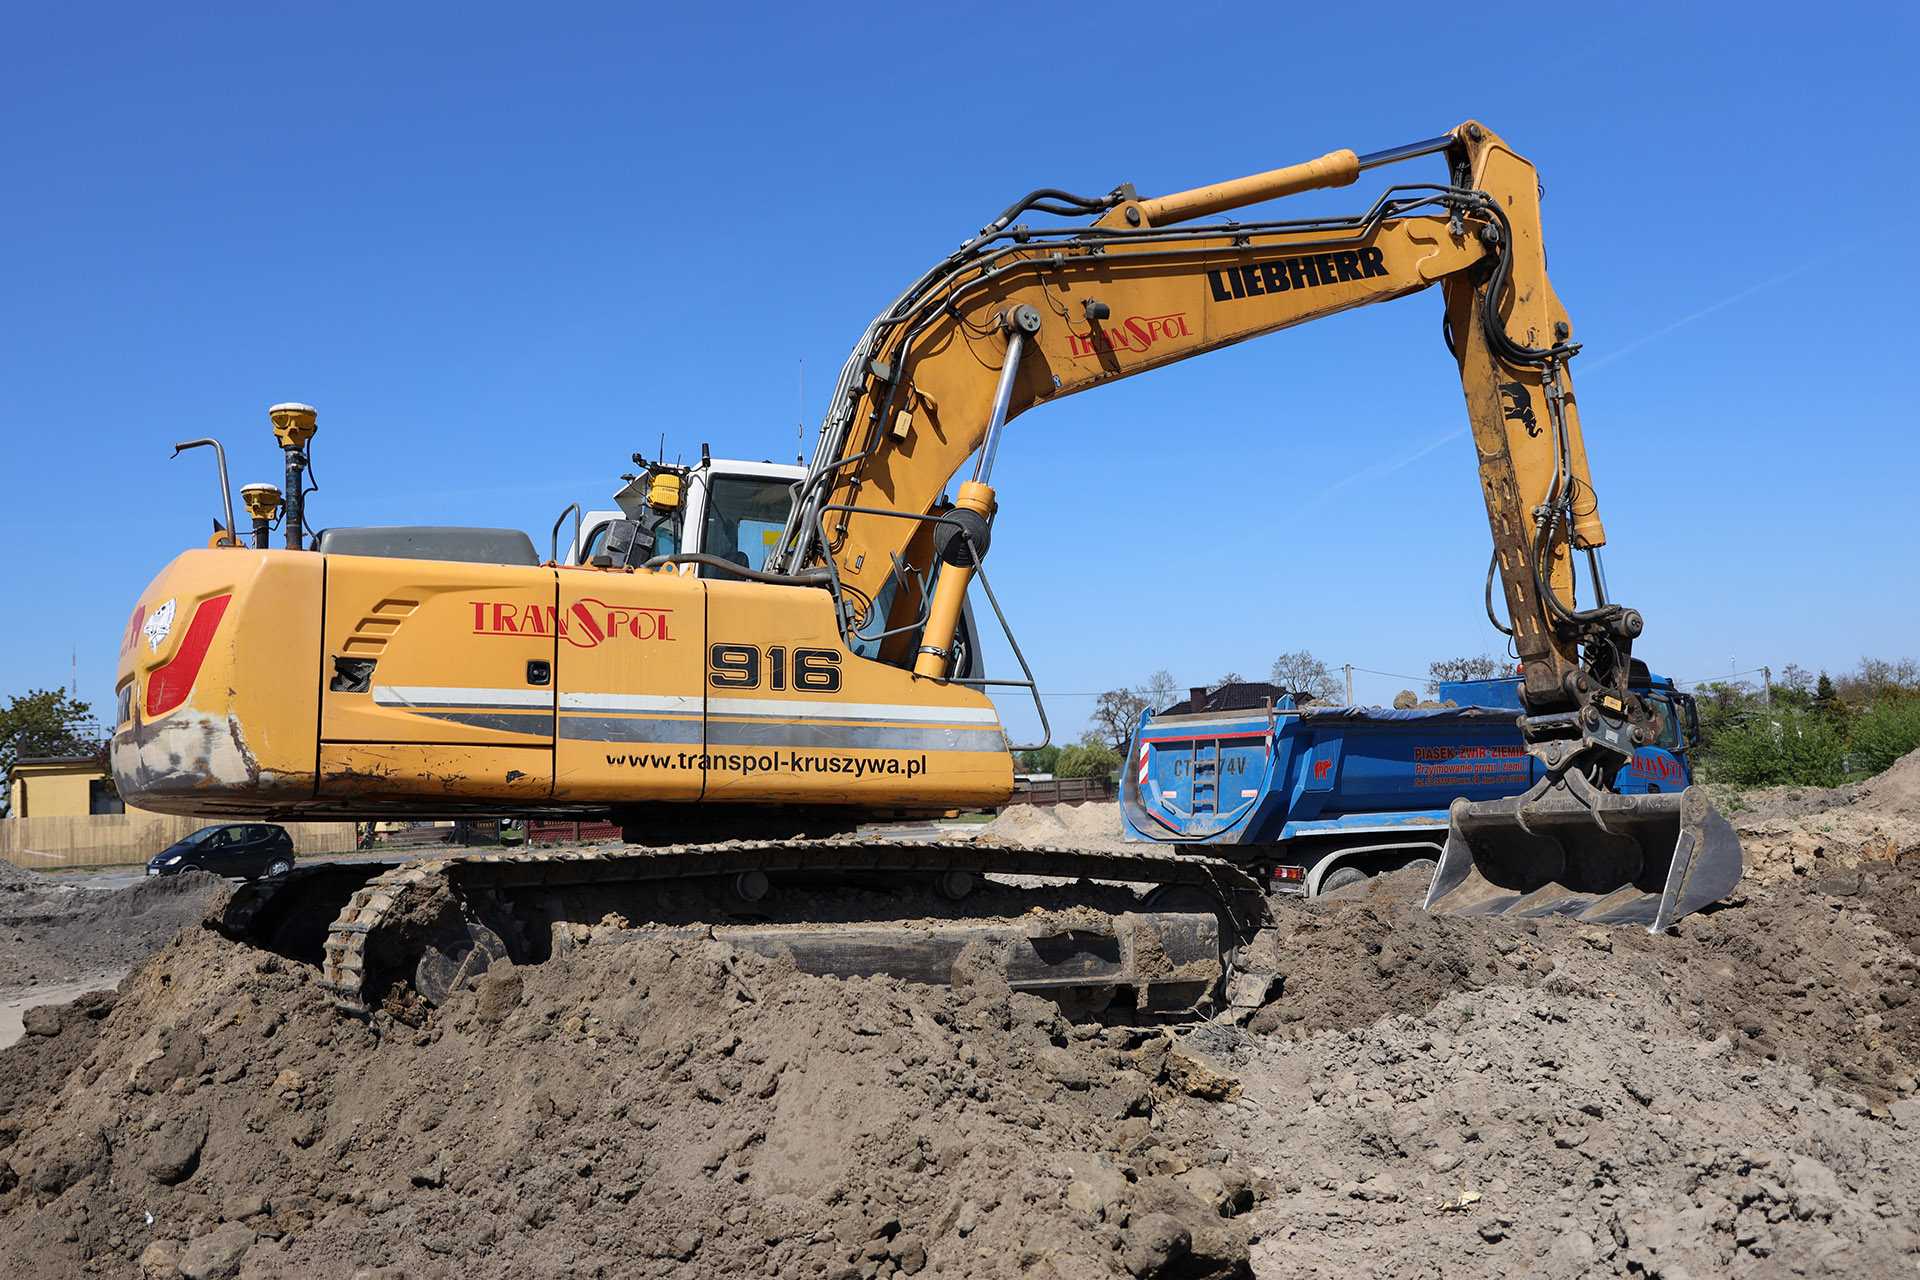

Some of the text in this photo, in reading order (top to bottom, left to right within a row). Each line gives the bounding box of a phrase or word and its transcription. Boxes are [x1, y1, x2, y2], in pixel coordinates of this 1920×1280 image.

[1207, 246, 1389, 303] LIEBHERR
[1065, 312, 1194, 359] TRANSPOL
[469, 598, 676, 648] TRANSPOL
[709, 642, 843, 693] 916
[606, 751, 927, 778] www.transpol-kruszywa.pl
